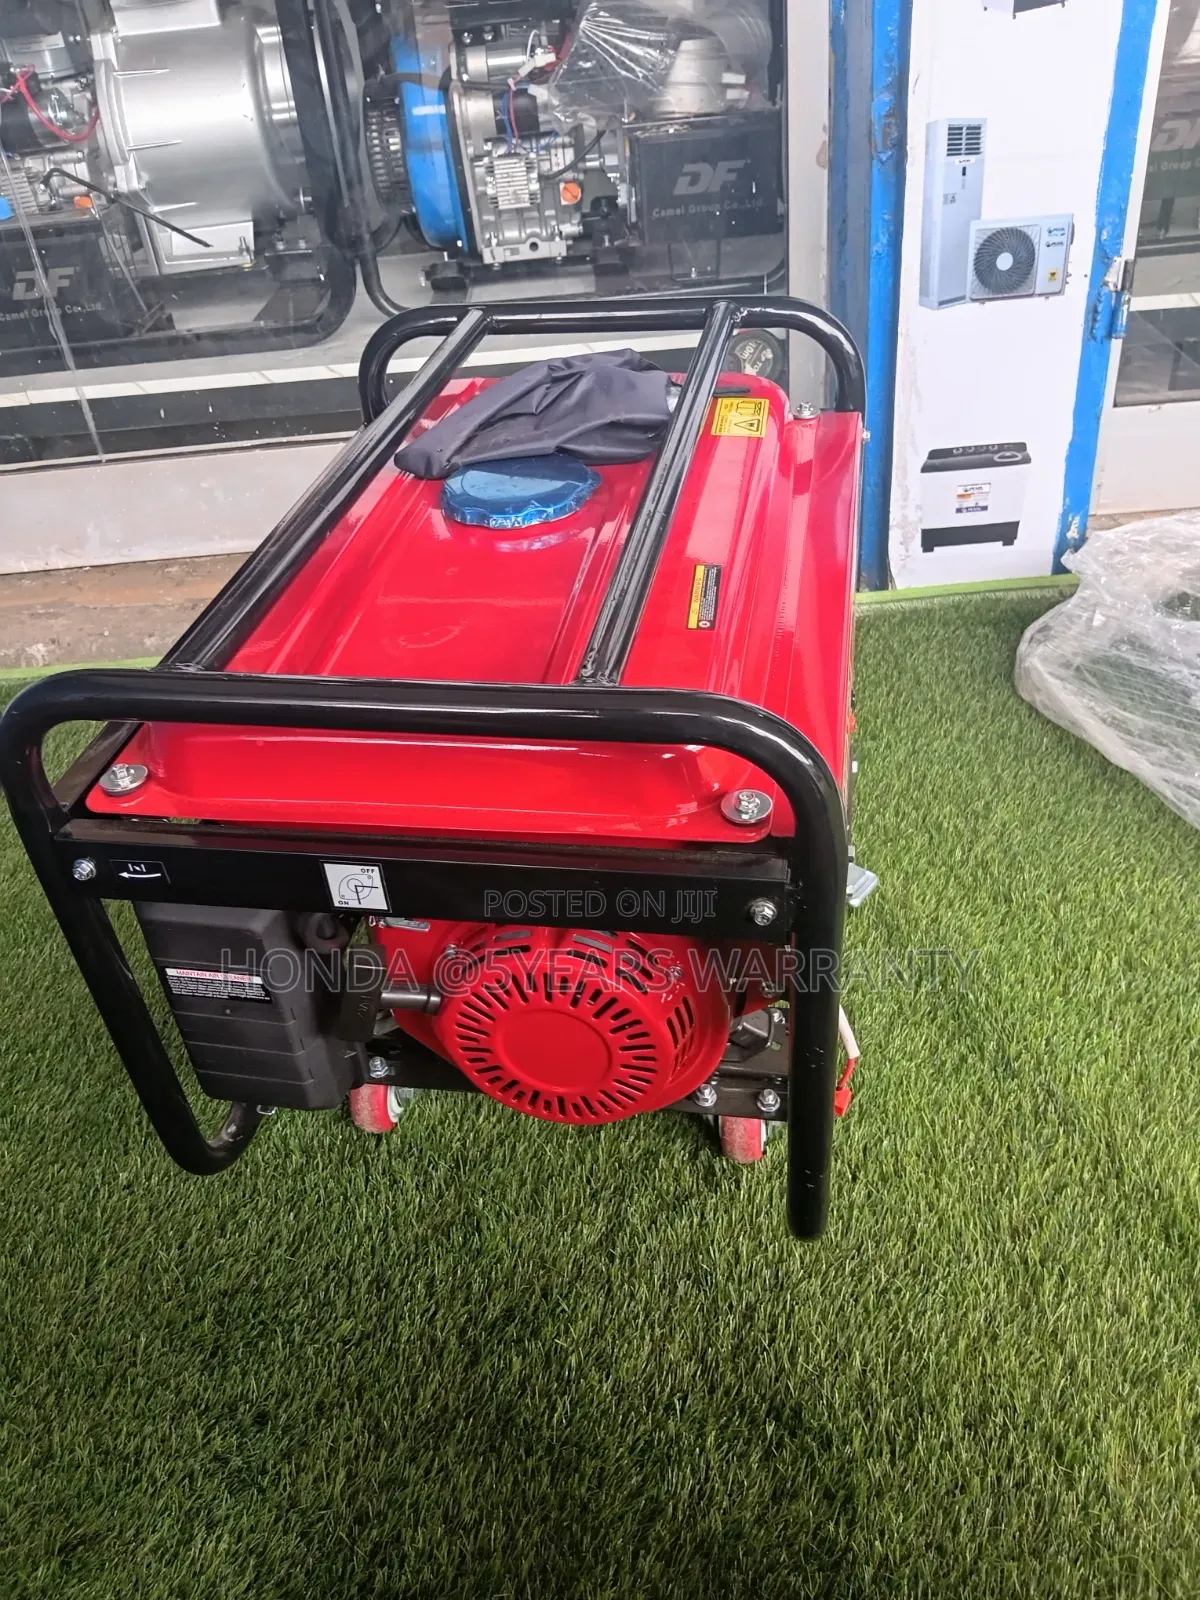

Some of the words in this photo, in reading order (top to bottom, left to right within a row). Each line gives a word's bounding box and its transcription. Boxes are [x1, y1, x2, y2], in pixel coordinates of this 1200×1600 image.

[672, 160, 746, 196] DF
[652, 204, 685, 217] Camel
[12, 266, 75, 301] DF
[693, 577, 702, 603] WARNING
[176, 970, 207, 979] MAINTAIN
